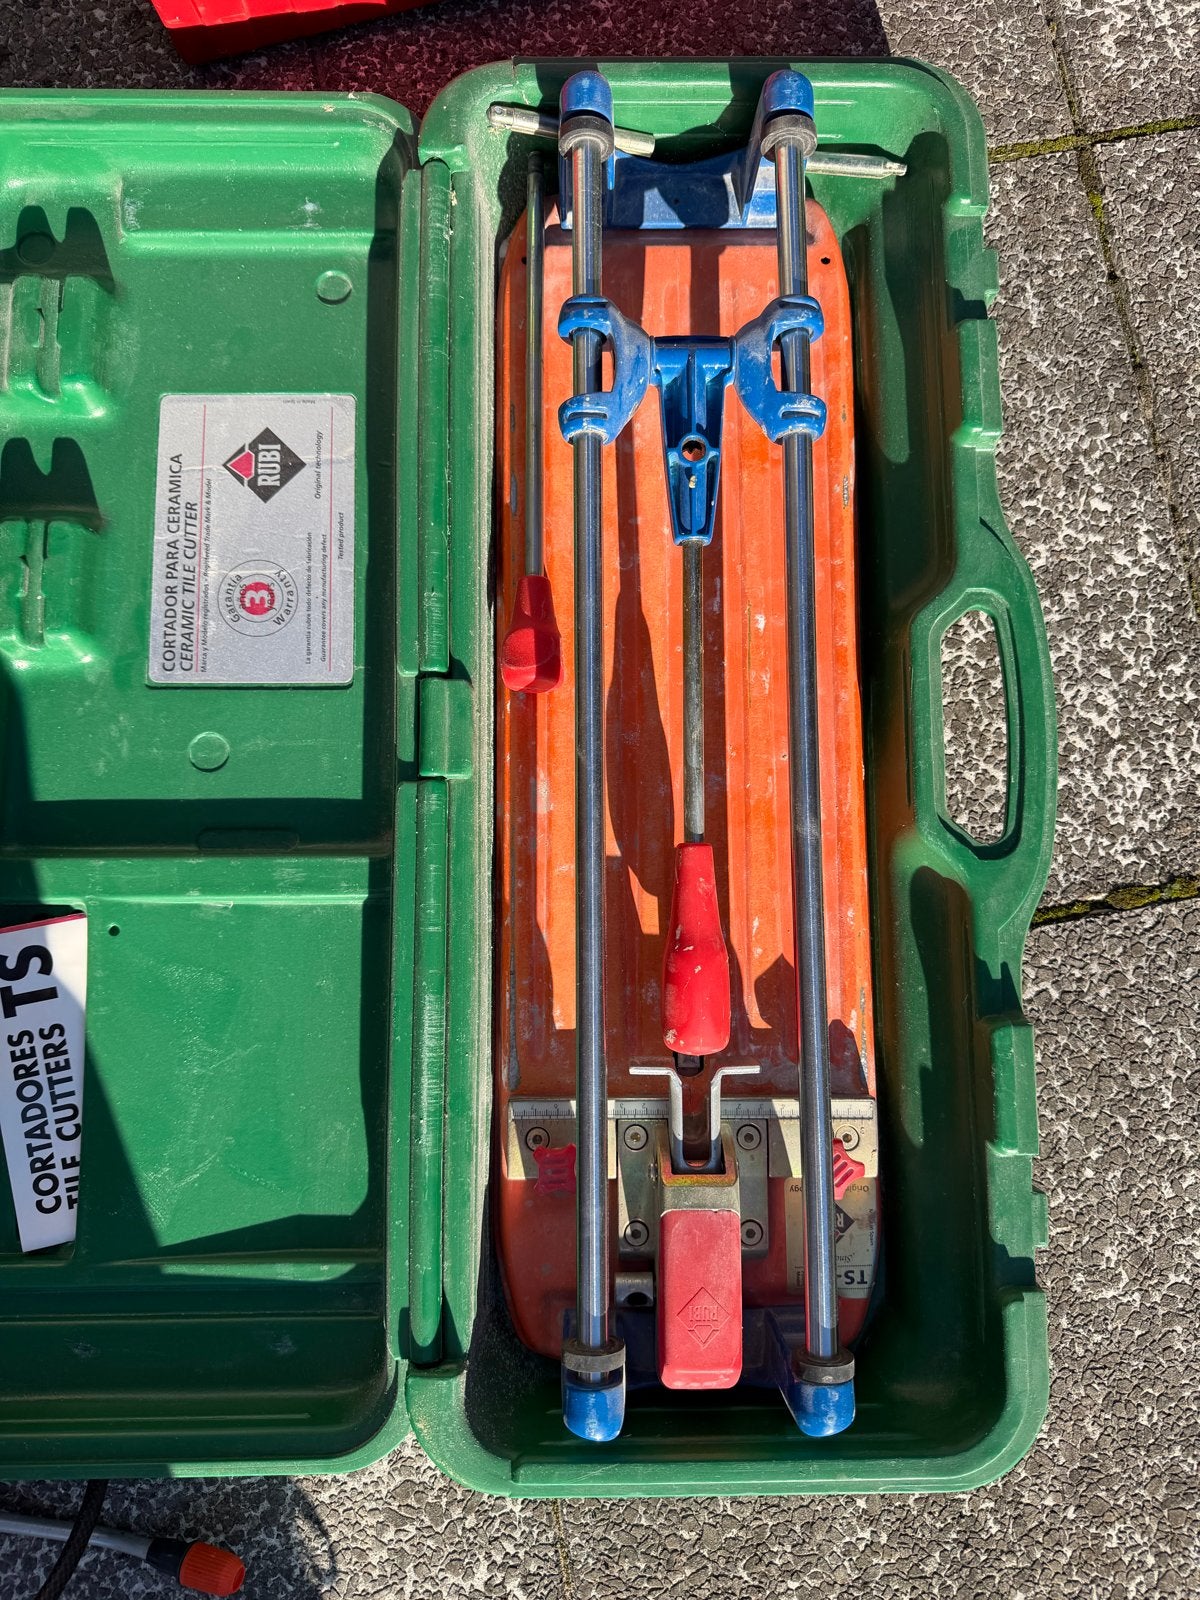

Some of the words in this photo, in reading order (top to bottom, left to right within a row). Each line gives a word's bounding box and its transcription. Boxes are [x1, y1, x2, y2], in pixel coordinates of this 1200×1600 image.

[258, 444, 281, 486] RUBI
[314, 430, 324, 469] technology
[167, 453, 182, 534] CERAMICA
[314, 471, 322, 500] Original
[183, 501, 198, 560] CUTTER
[338, 512, 346, 538] product
[166, 540, 180, 580] PARA
[182, 564, 196, 594] TILE
[202, 584, 210, 620] registrados
[246, 589, 268, 608] 3
[266, 582, 278, 612] years
[272, 569, 294, 626] Warranty
[162, 585, 178, 672] CORTADOR
[180, 600, 195, 672] CERAMIC
[200, 652, 208, 673] Marca
[0, 944, 58, 1018] TS
[39, 1023, 82, 1142] CUTTERS
[7, 1030, 62, 1214] CORTADORES
[689, 1306, 718, 1322] RUBI
